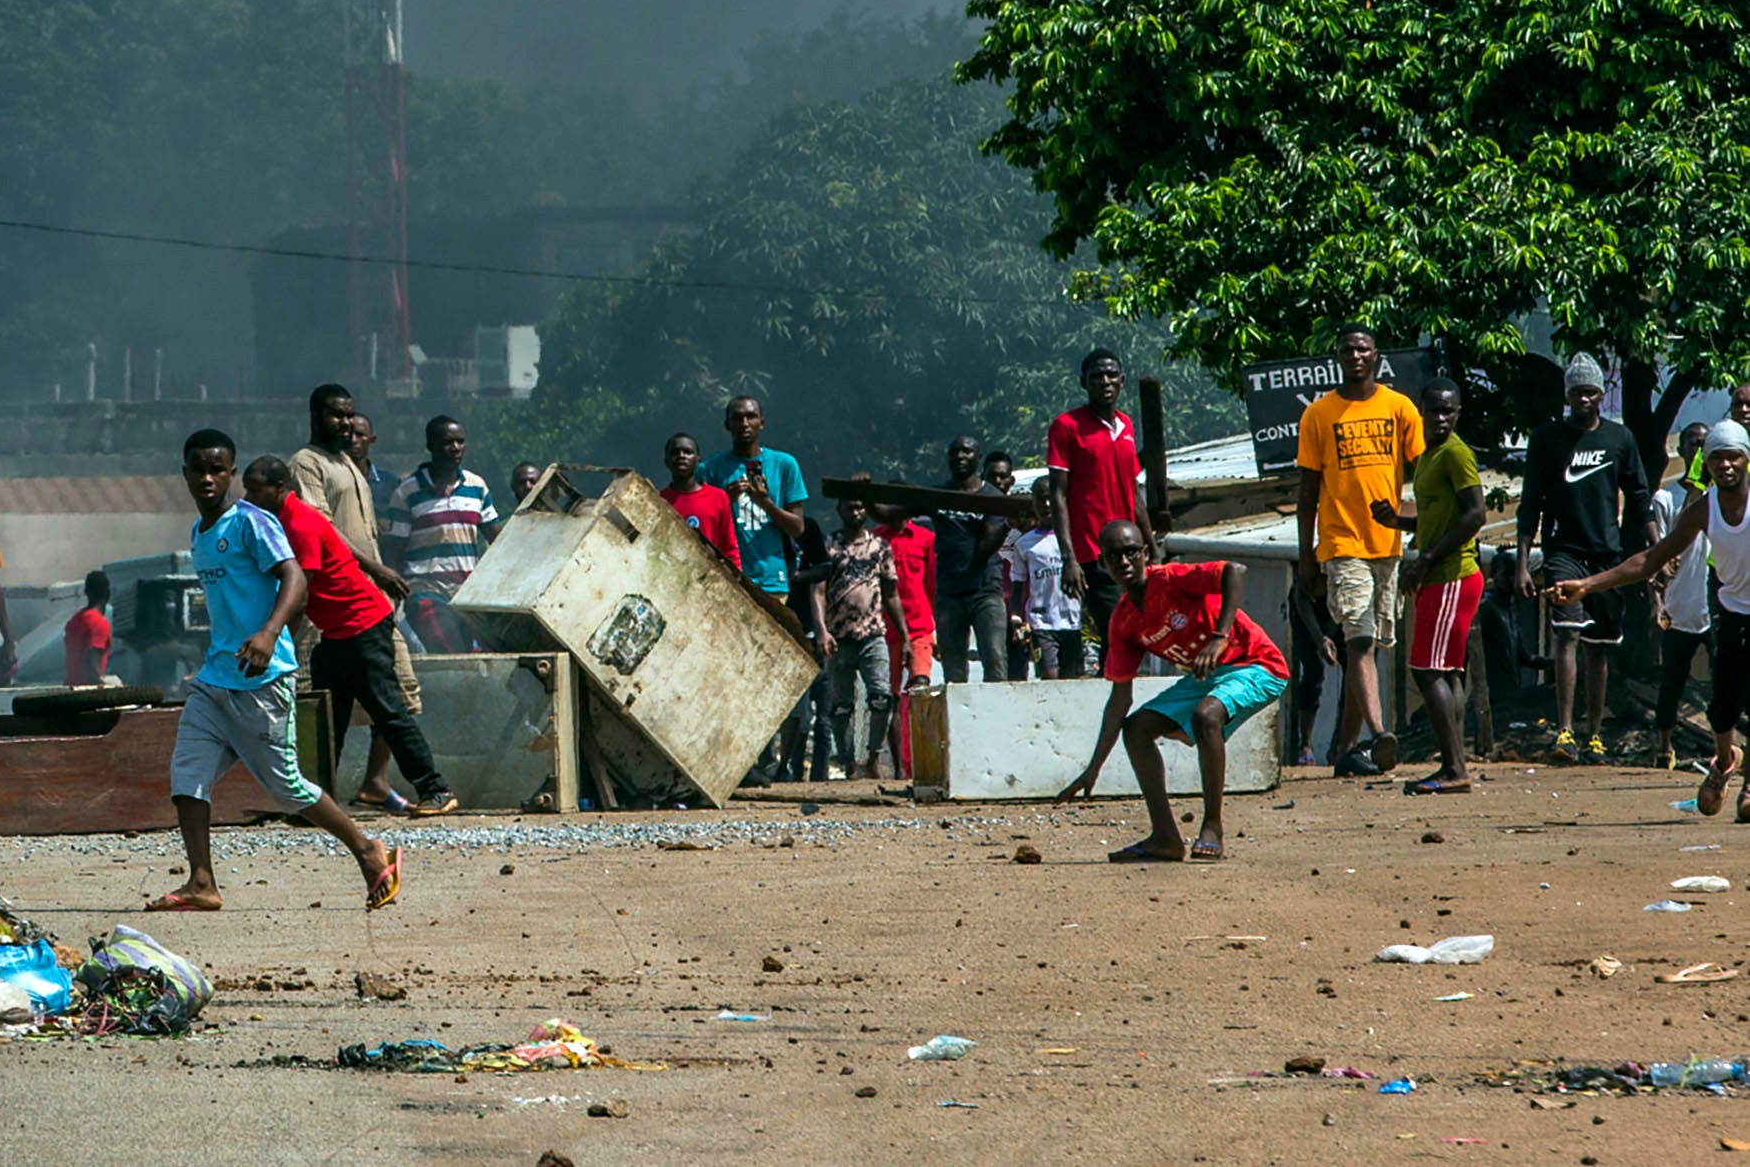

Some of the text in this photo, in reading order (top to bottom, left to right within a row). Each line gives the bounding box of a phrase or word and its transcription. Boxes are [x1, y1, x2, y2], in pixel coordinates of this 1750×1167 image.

[1255, 422, 1300, 442] CONT
[1343, 420, 1386, 438] EVENT
[1571, 449, 1606, 466] NIKE
